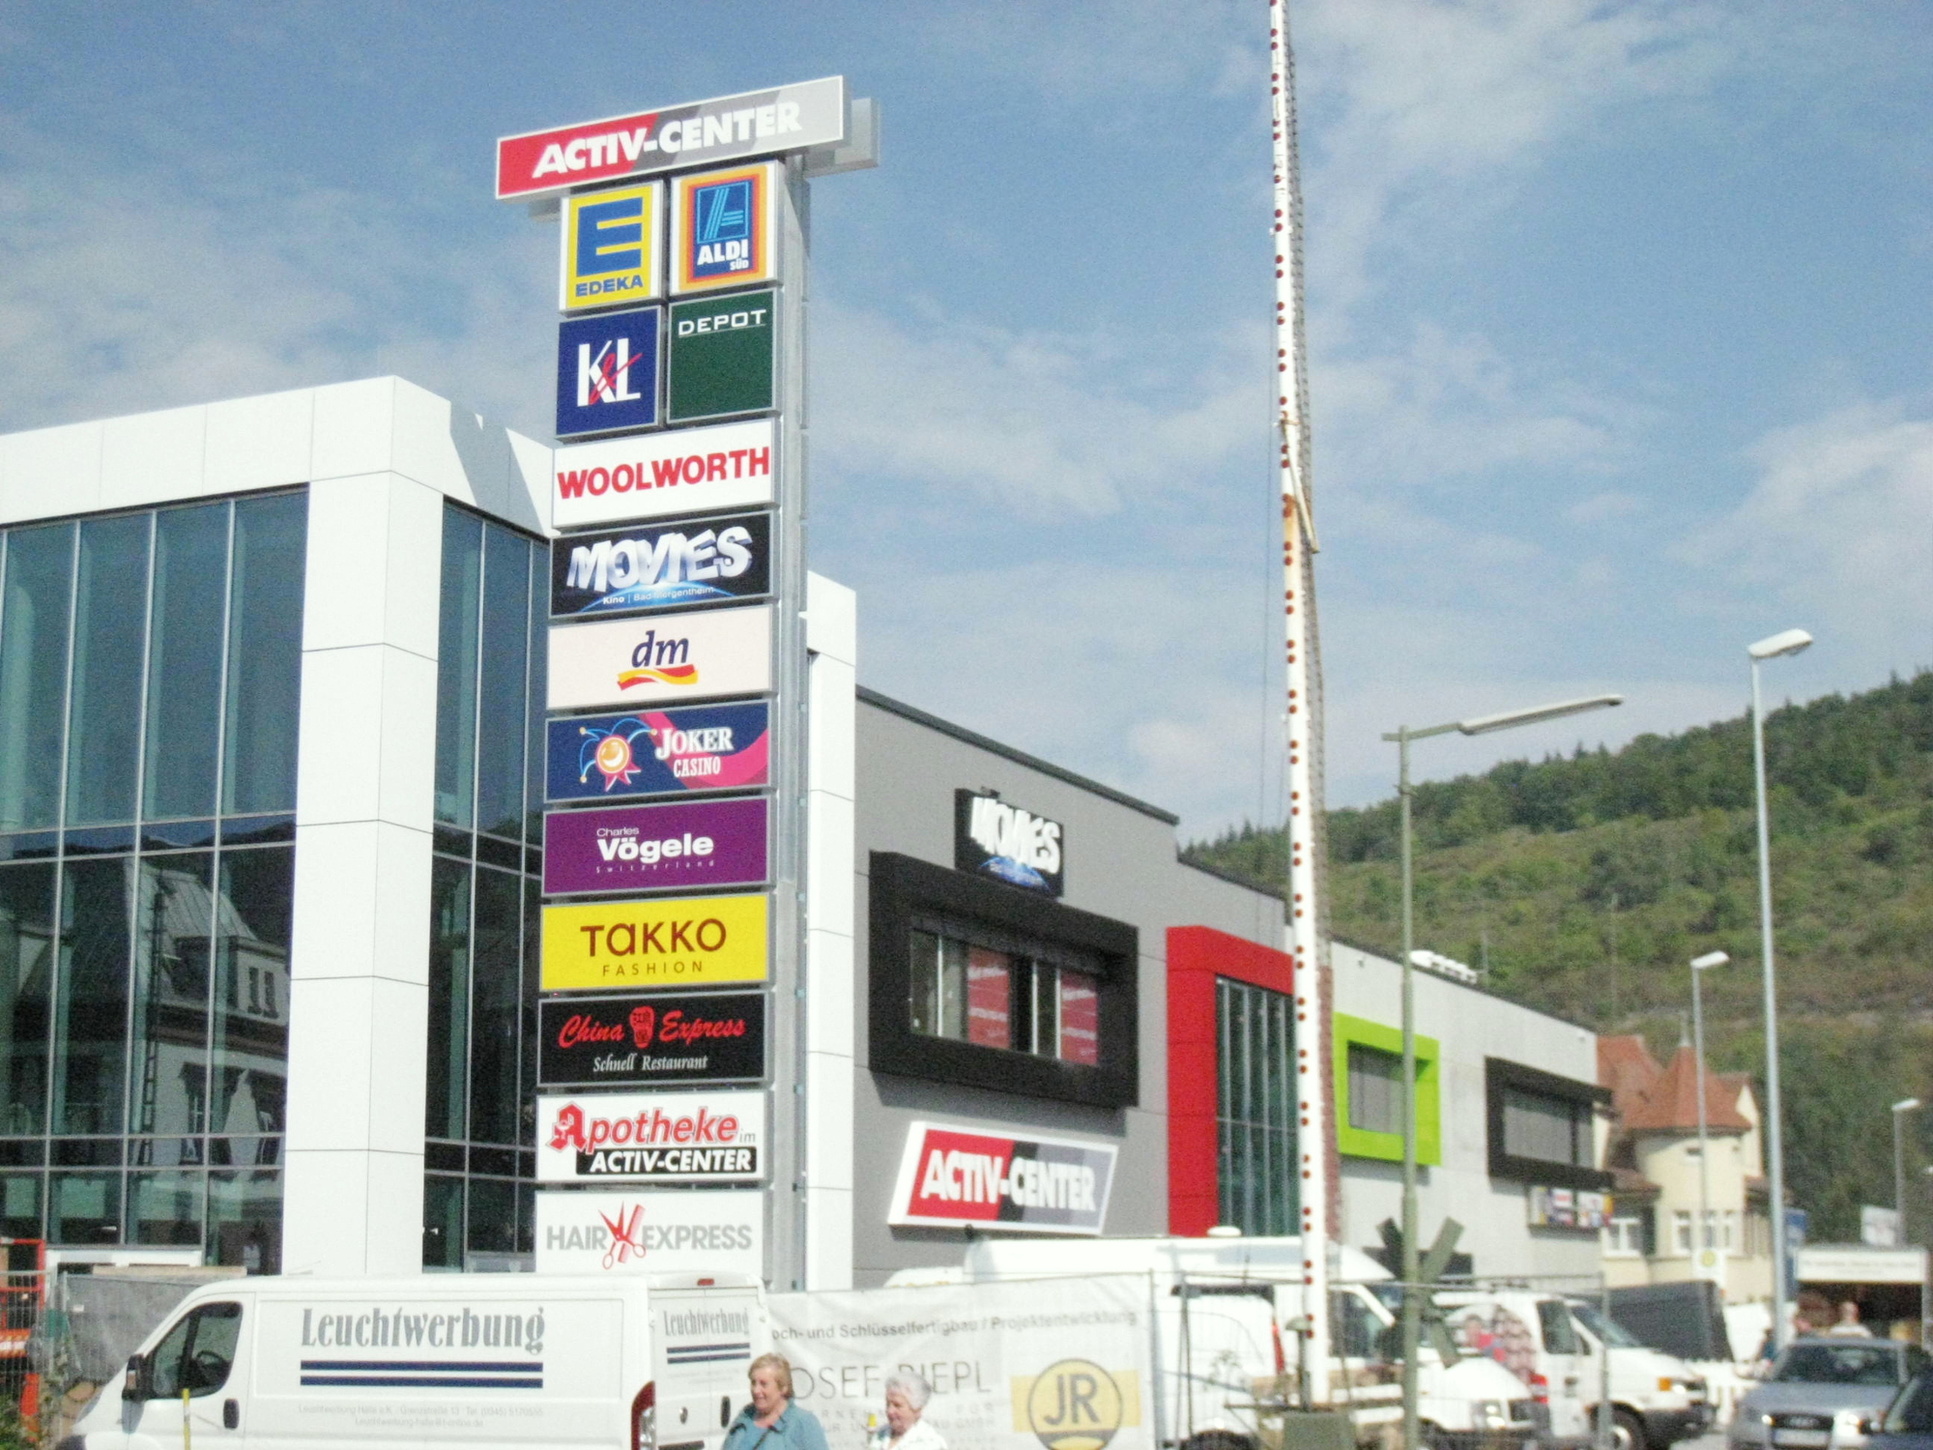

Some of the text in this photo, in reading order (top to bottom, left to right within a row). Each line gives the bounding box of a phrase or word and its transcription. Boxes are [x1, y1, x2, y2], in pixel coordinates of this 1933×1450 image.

[532, 101, 802, 179] ACTIV-CENTER
[697, 239, 749, 266] ALDI
[729, 258, 749, 271] SÜD
[575, 274, 644, 298] EDEKA
[678, 309, 767, 337] DEPOT
[556, 446, 770, 500] WOOLWORTH
[566, 525, 753, 593] MOVIES
[602, 596, 625, 605] Kino
[631, 630, 689, 668] dm
[654, 727, 734, 761] JOKER
[673, 756, 722, 778] CASINO
[596, 826, 640, 838] Charles
[597, 833, 714, 864] Vögele
[602, 961, 703, 977] FASHION
[558, 1010, 746, 1048] China Express
[593, 1053, 709, 1073] Schnell Restaurant
[546, 1101, 756, 1155] Apotheke im
[590, 1149, 751, 1173] ACTIV-CENTER
[920, 1149, 1097, 1212] ACTIV-CENTER
[546, 1225, 753, 1250] HAIR EXPRESS
[300, 1306, 546, 1356] Leuchtwerbung
[663, 1307, 750, 1337] Leuchtwerbung
[772, 1323, 804, 1341] och-
[808, 1325, 835, 1340] und
[839, 1319, 978, 1340] Schlüsselfertigbau
[790, 1365, 880, 1400] OSEF
[1043, 1373, 1101, 1426] JR
